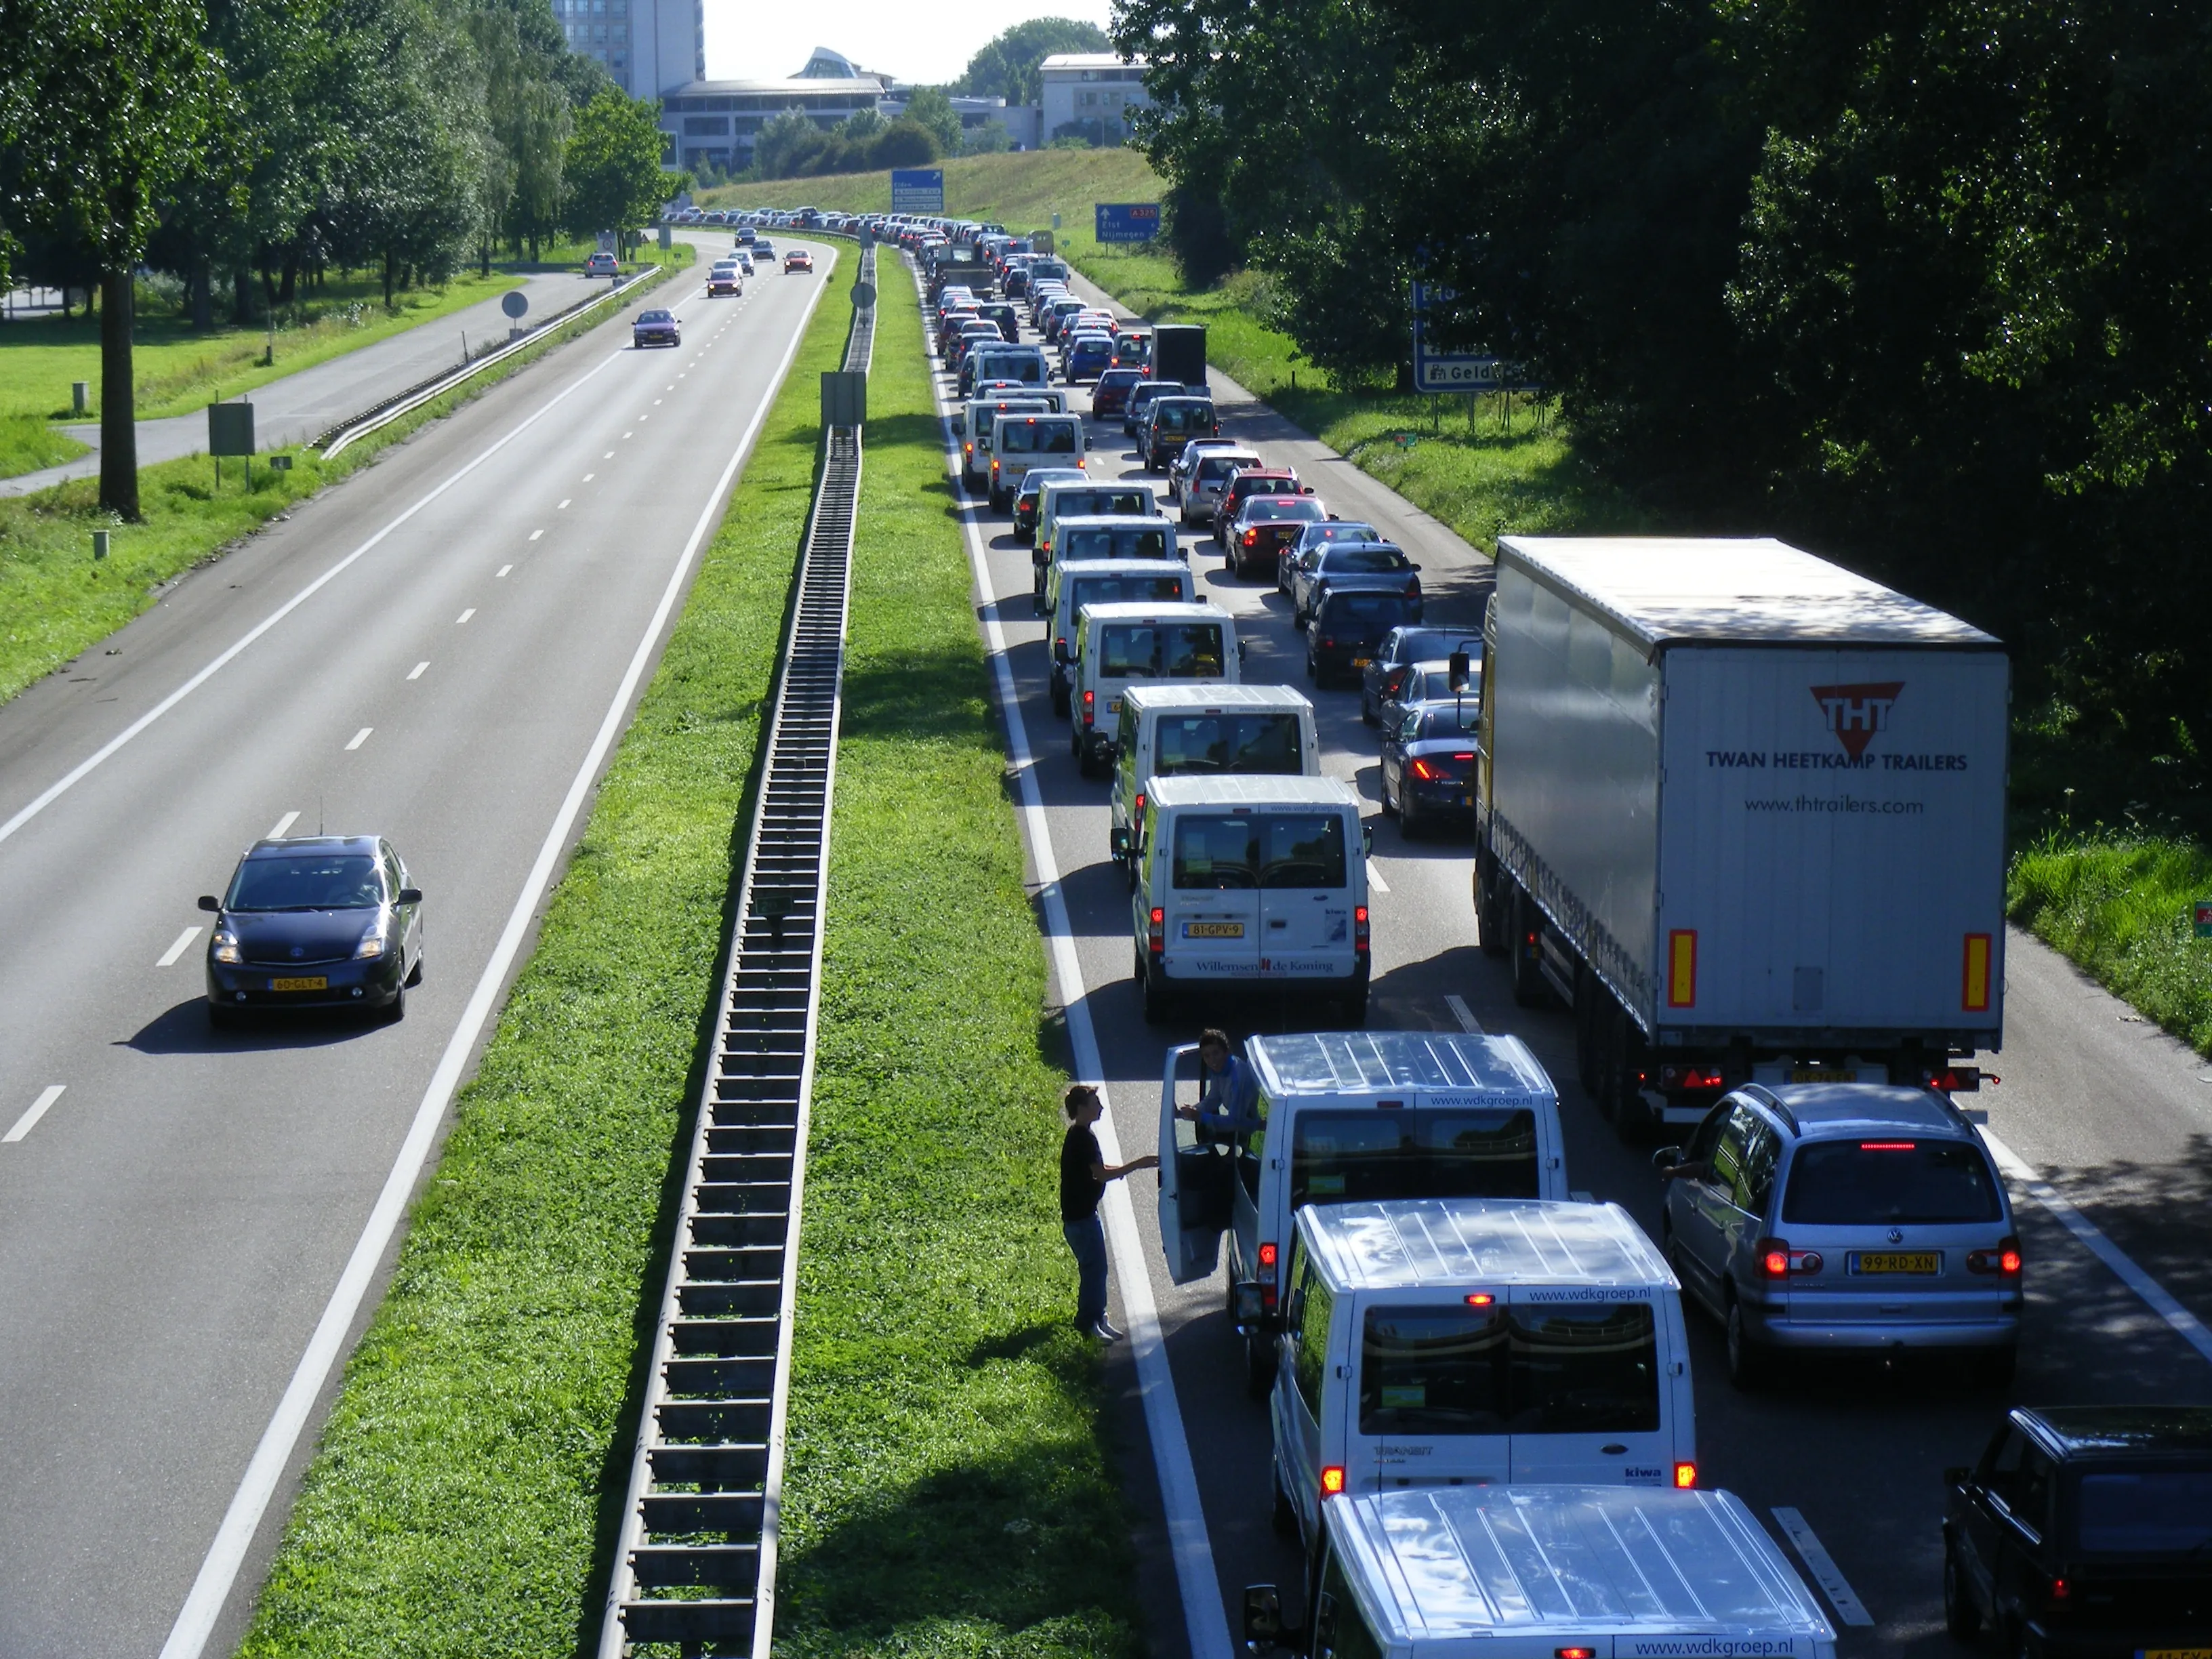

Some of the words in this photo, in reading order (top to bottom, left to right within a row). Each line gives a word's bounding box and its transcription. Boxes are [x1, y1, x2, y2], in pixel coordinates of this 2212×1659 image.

[1102, 220, 1120, 228] Elst
[1101, 231, 1145, 240] Nijmegen
[1822, 698, 1894, 731] THT
[1706, 751, 1765, 769] TWAN
[1774, 752, 1875, 770] HEETKAMP
[1882, 754, 1967, 771] TRAILERS
[1271, 804, 1342, 813] www.wdkgroep.nl
[1745, 794, 1923, 815] www.thtrailers.com
[1193, 924, 1239, 935] 81-GPV-9
[1196, 960, 1258, 972] Willemsen
[1273, 961, 1288, 971] de
[1290, 960, 1334, 973] Koning
[276, 978, 324, 989] 60-GLT-4
[1431, 1095, 1532, 1107] www.wdkgroep.nl
[1864, 1256, 1934, 1270] 99-RD-XN
[1530, 1287, 1651, 1302] www.wdkgroep.nl
[1625, 1467, 1661, 1477] kiwa
[1635, 1638, 1793, 1657] www.wdkgroep.nl
